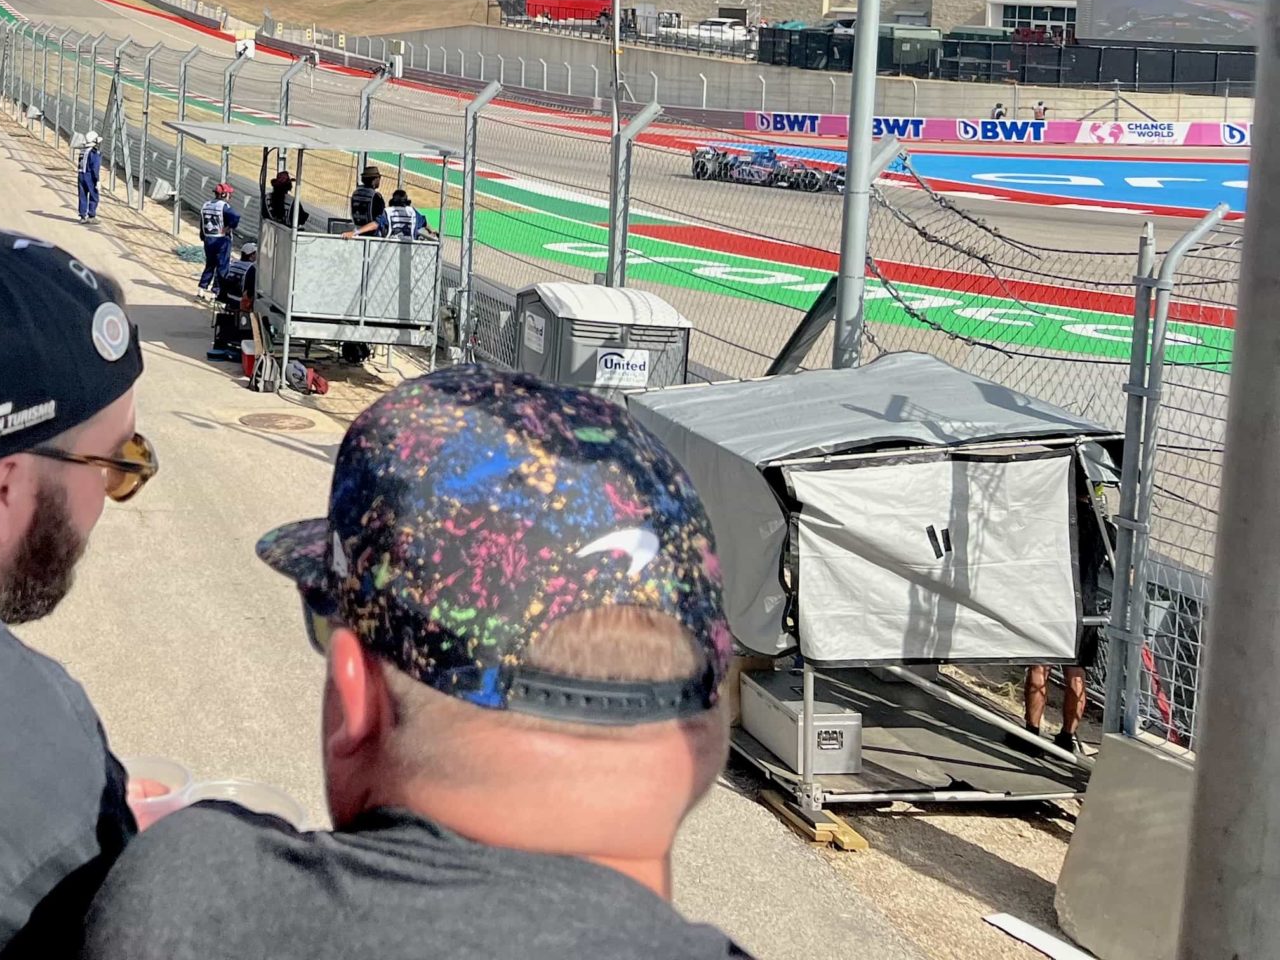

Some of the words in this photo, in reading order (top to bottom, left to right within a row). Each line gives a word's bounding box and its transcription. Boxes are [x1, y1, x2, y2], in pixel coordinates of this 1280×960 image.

[773, 113, 819, 133] BWT
[873, 118, 923, 138] BWT
[981, 121, 1045, 141] BWT
[604, 357, 646, 372] United
[6, 400, 56, 428] TURISMO
